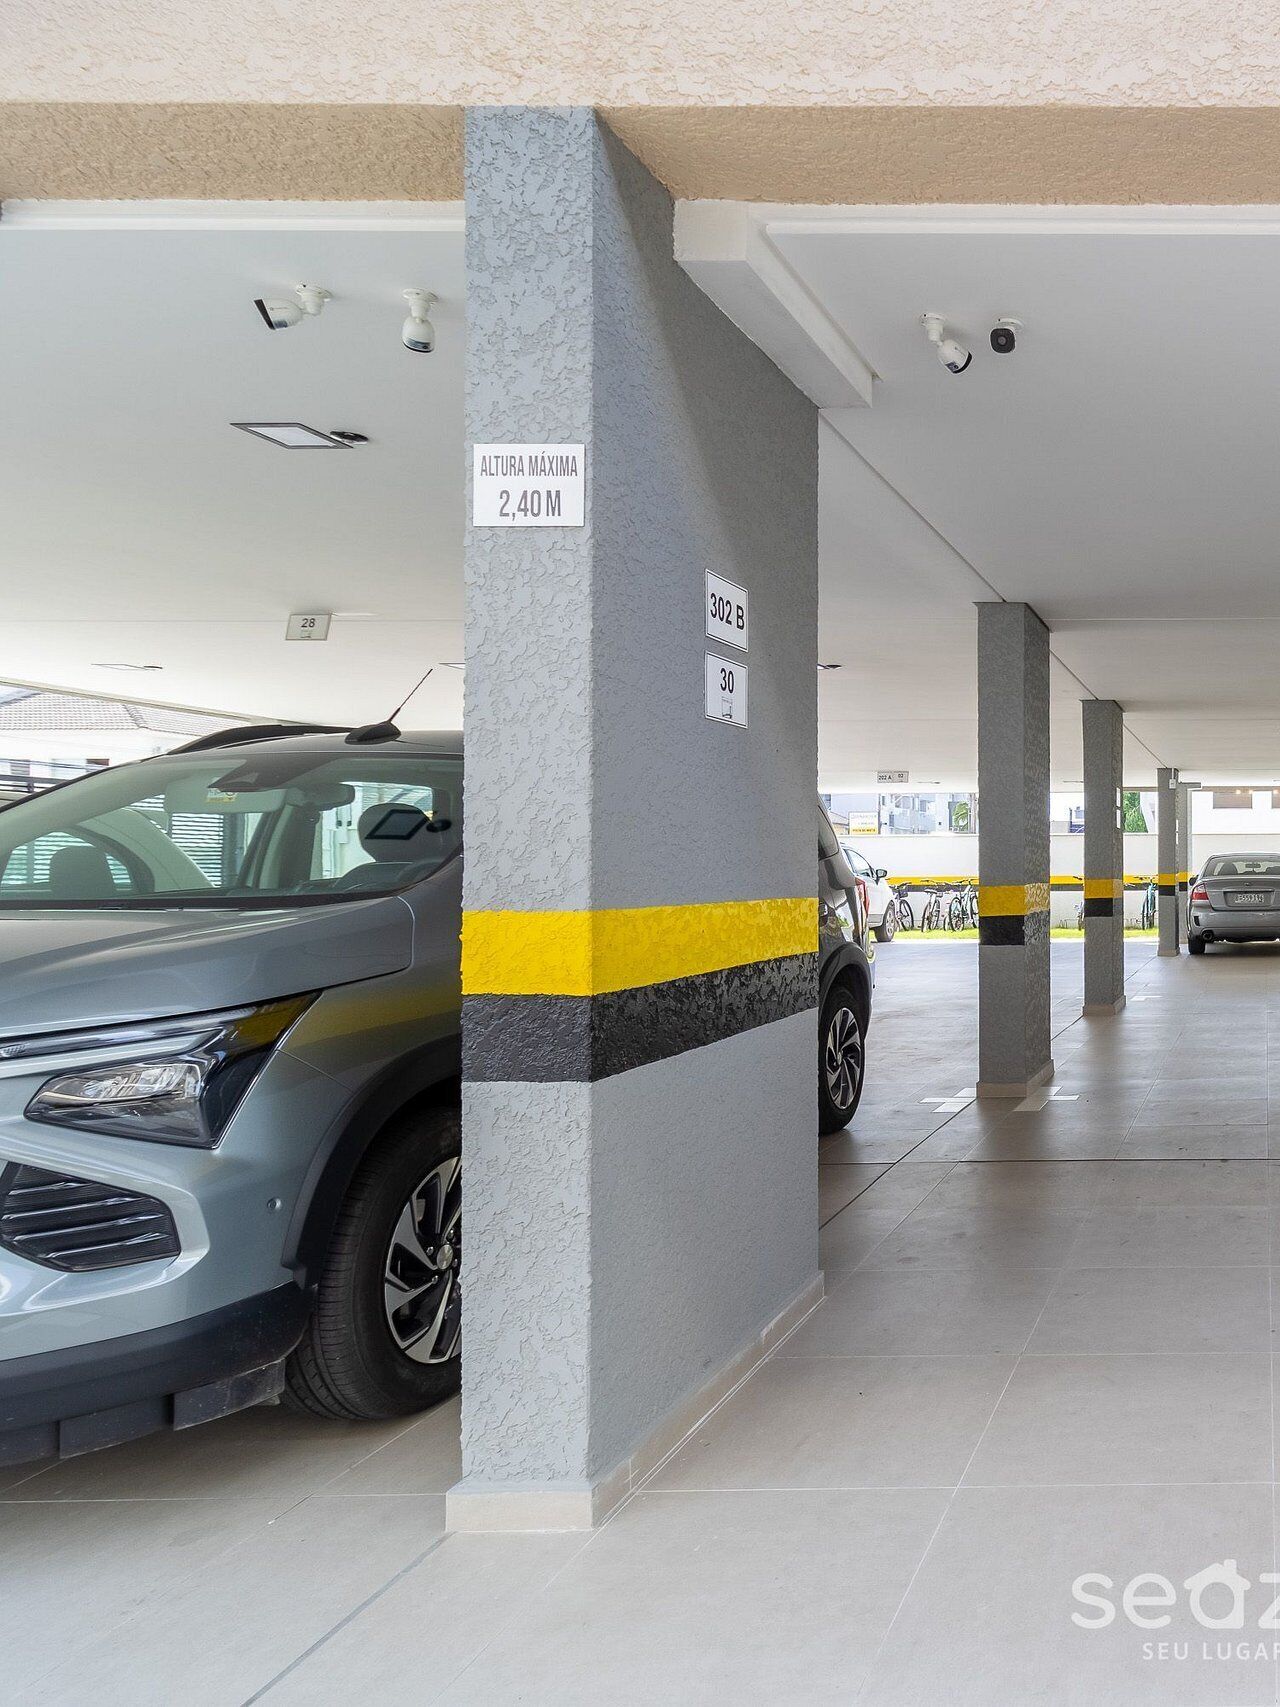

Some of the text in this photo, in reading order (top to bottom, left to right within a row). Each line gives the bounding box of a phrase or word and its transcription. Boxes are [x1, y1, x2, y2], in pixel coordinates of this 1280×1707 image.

[480, 450, 578, 476] ALTURA MÁXIMA
[499, 489, 562, 521] 2,40 M
[301, 617, 316, 628] 28
[710, 592, 745, 630] 302 B
[720, 667, 735, 694] 30
